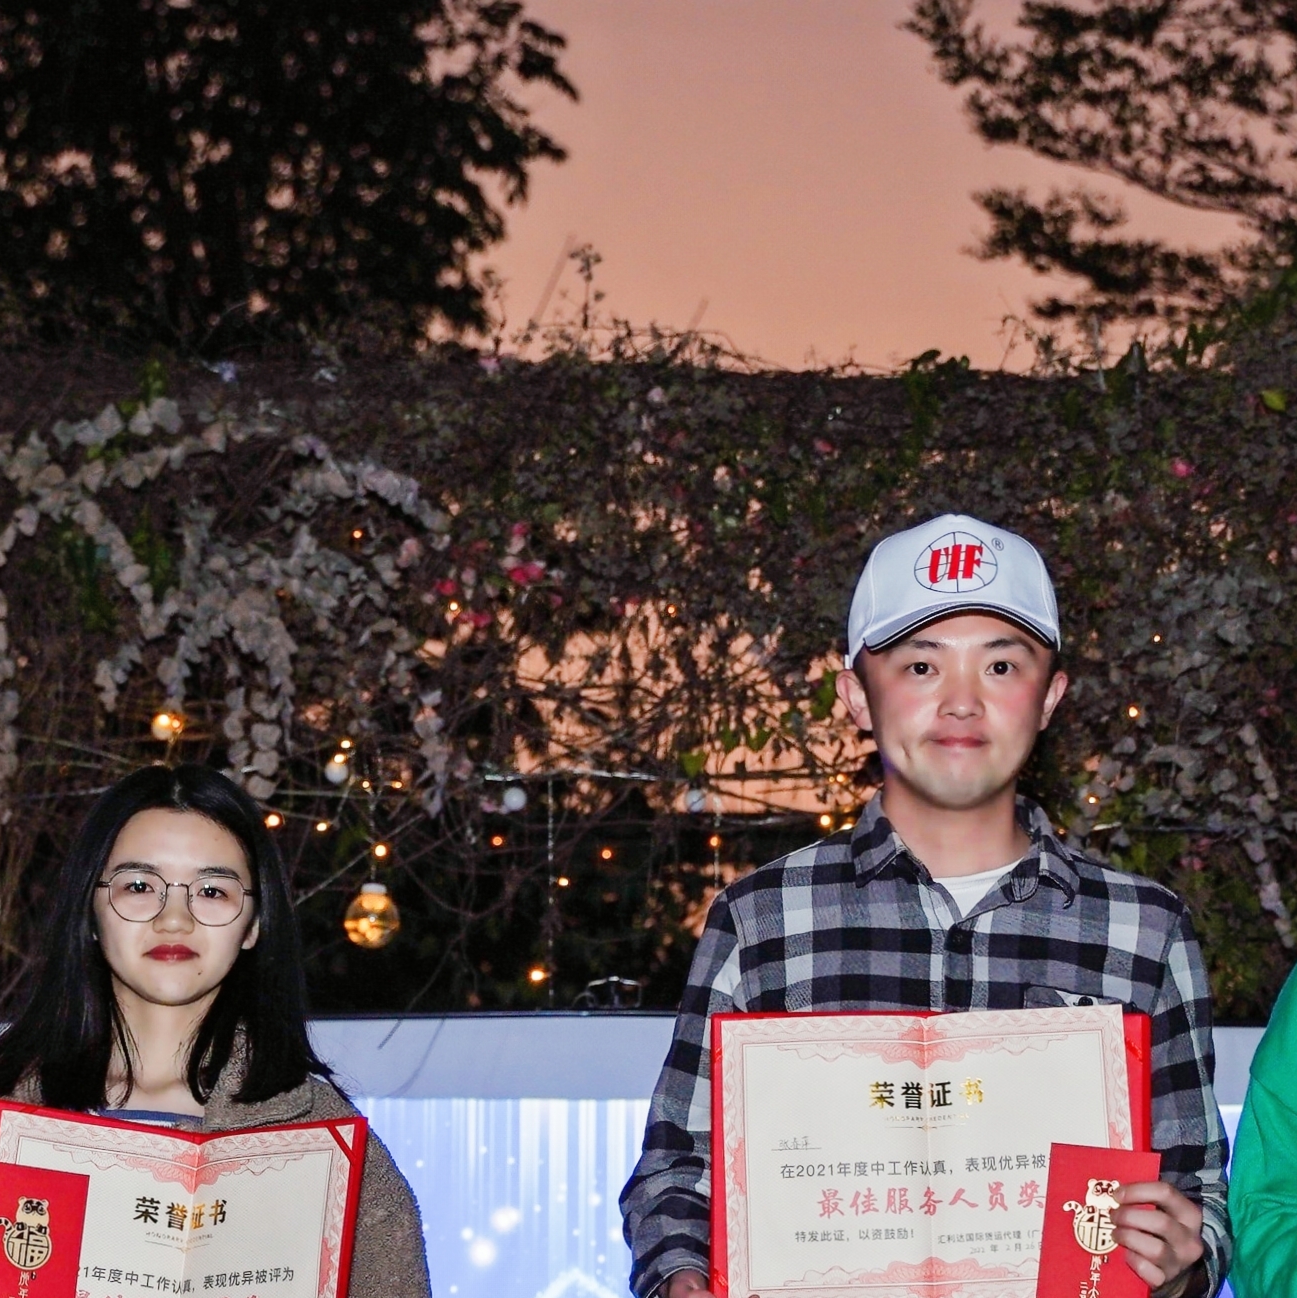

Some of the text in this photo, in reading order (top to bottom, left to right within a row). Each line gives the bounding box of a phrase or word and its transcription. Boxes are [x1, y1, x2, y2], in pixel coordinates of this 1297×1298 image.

[869, 1077, 984, 1109] 荣誉证书
[780, 1153, 1051, 1179] 在2021年度中工作认真，表现优异被
[133, 1196, 227, 1231] 荣誉证书
[817, 1180, 1046, 1219] 最佳服务人员奖
